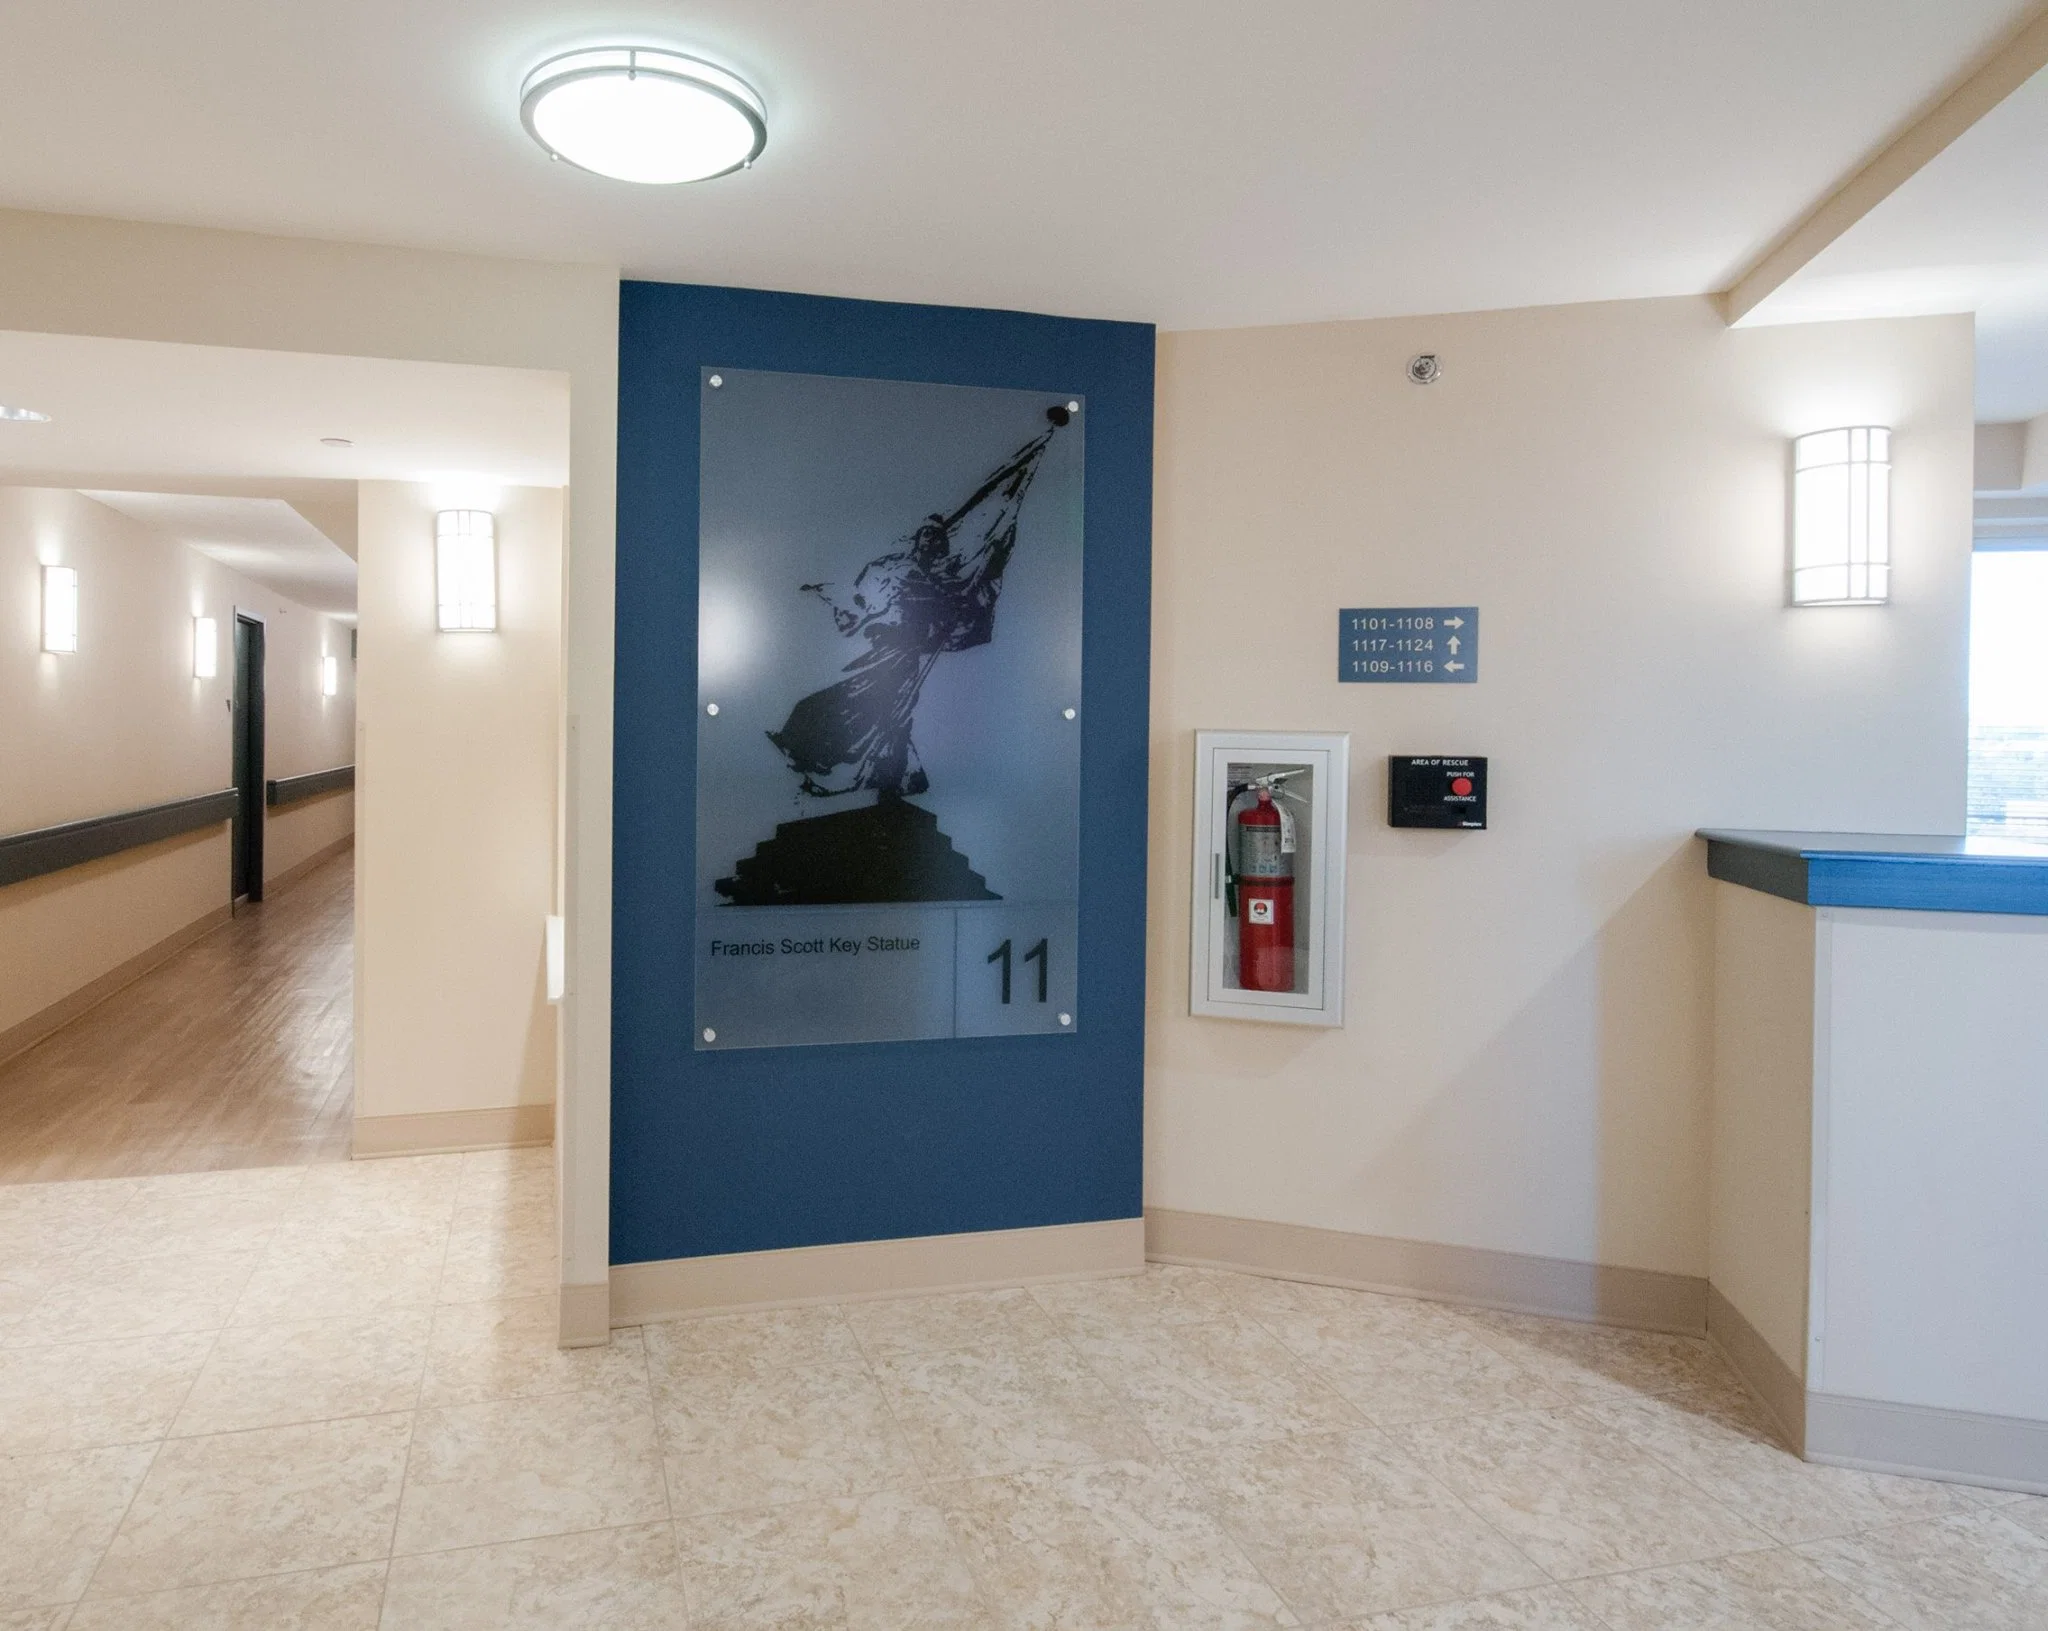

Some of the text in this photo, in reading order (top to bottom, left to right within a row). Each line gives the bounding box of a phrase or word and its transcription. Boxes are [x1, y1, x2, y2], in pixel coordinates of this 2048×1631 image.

[1352, 617, 1434, 630] 1101-1108
[1352, 639, 1434, 652] 1117-1124
[1352, 660, 1434, 673] 1109-1116
[711, 935, 920, 957] Francis Scott Key Statue
[987, 938, 1048, 1005] 11
